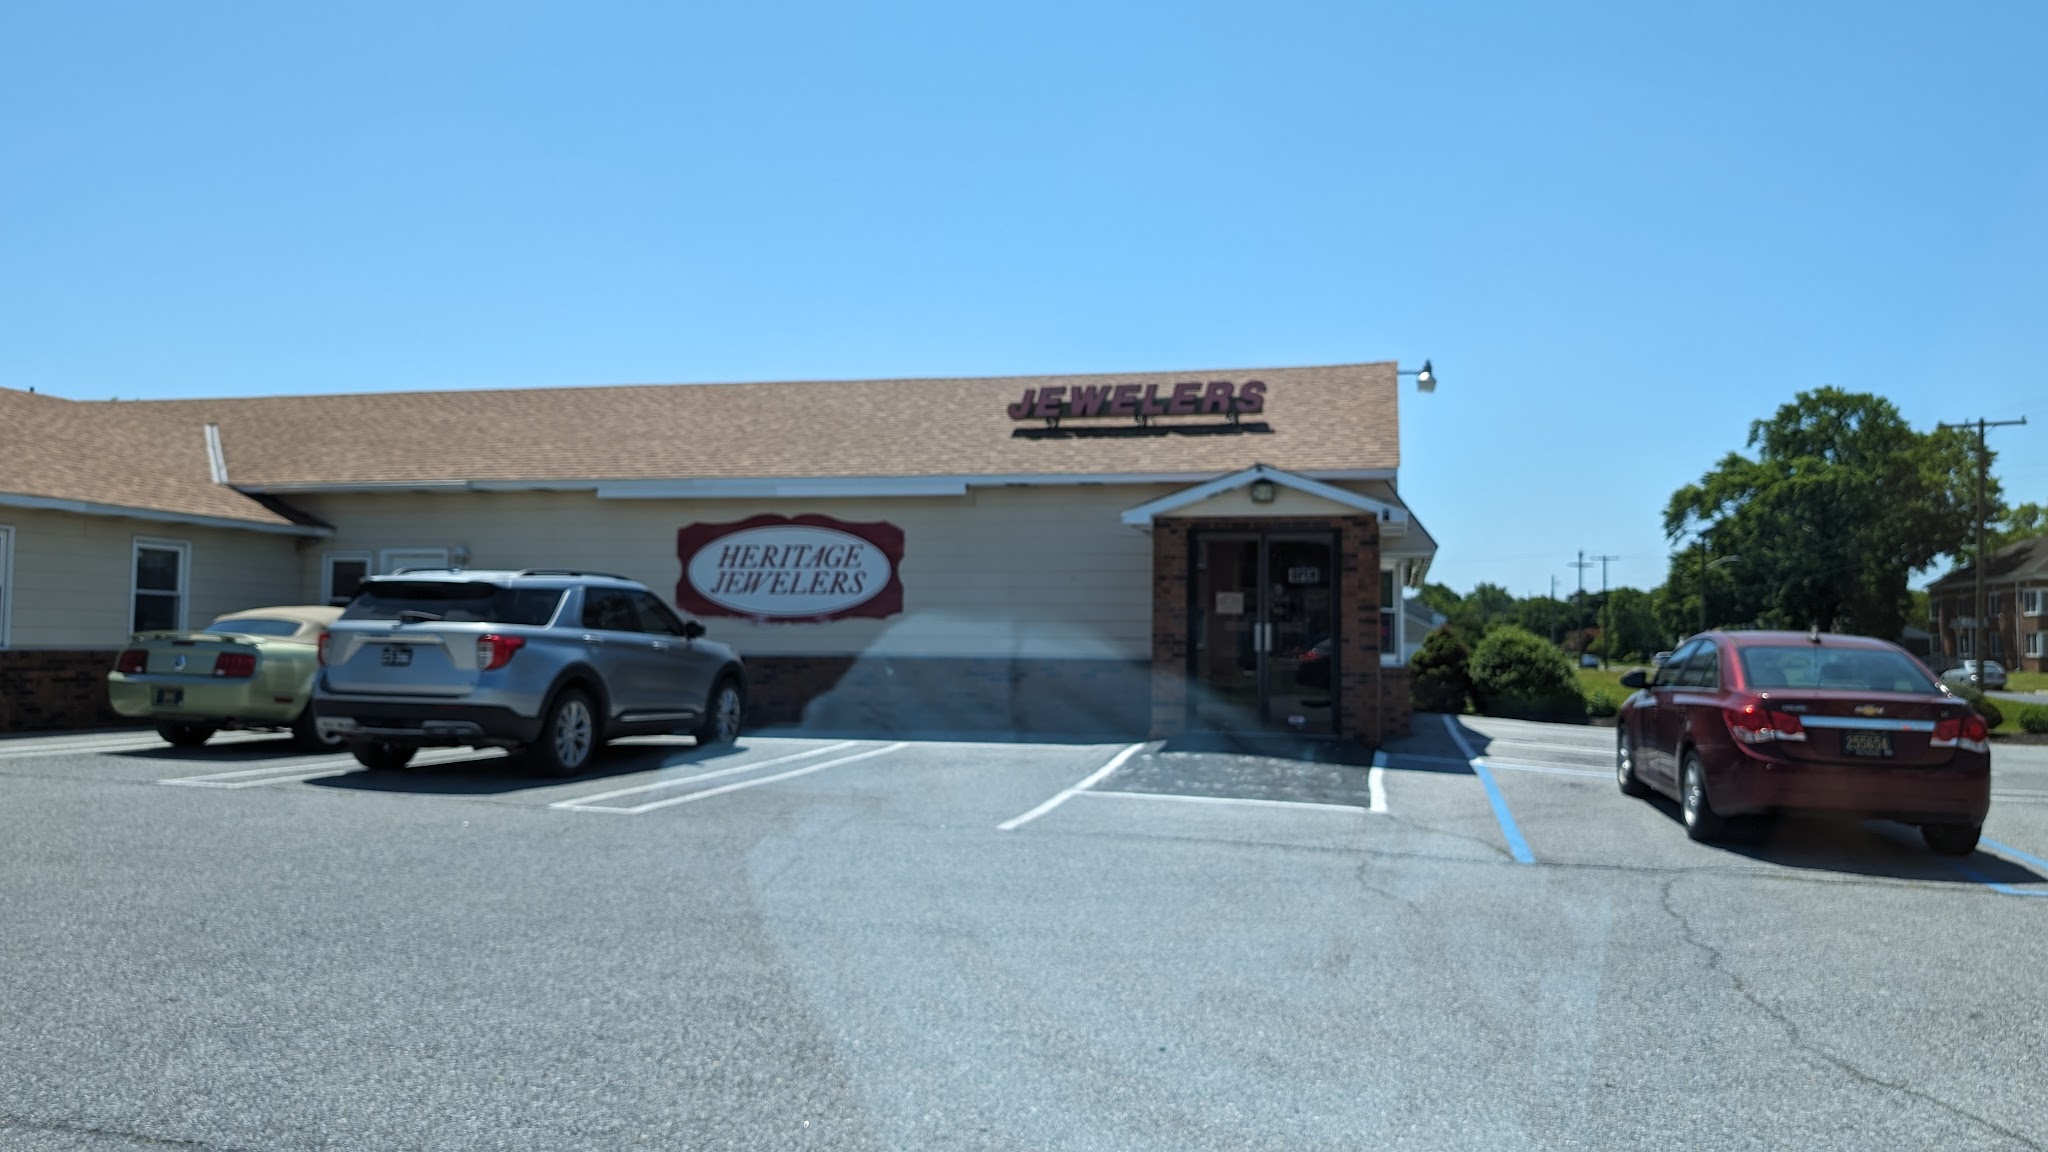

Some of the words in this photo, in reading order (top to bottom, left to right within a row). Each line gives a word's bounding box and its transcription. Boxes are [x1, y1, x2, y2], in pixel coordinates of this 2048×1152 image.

[1007, 380, 1267, 420] JEWELERS
[718, 544, 864, 569] HERITAGE
[710, 570, 867, 595] JEWELERS
